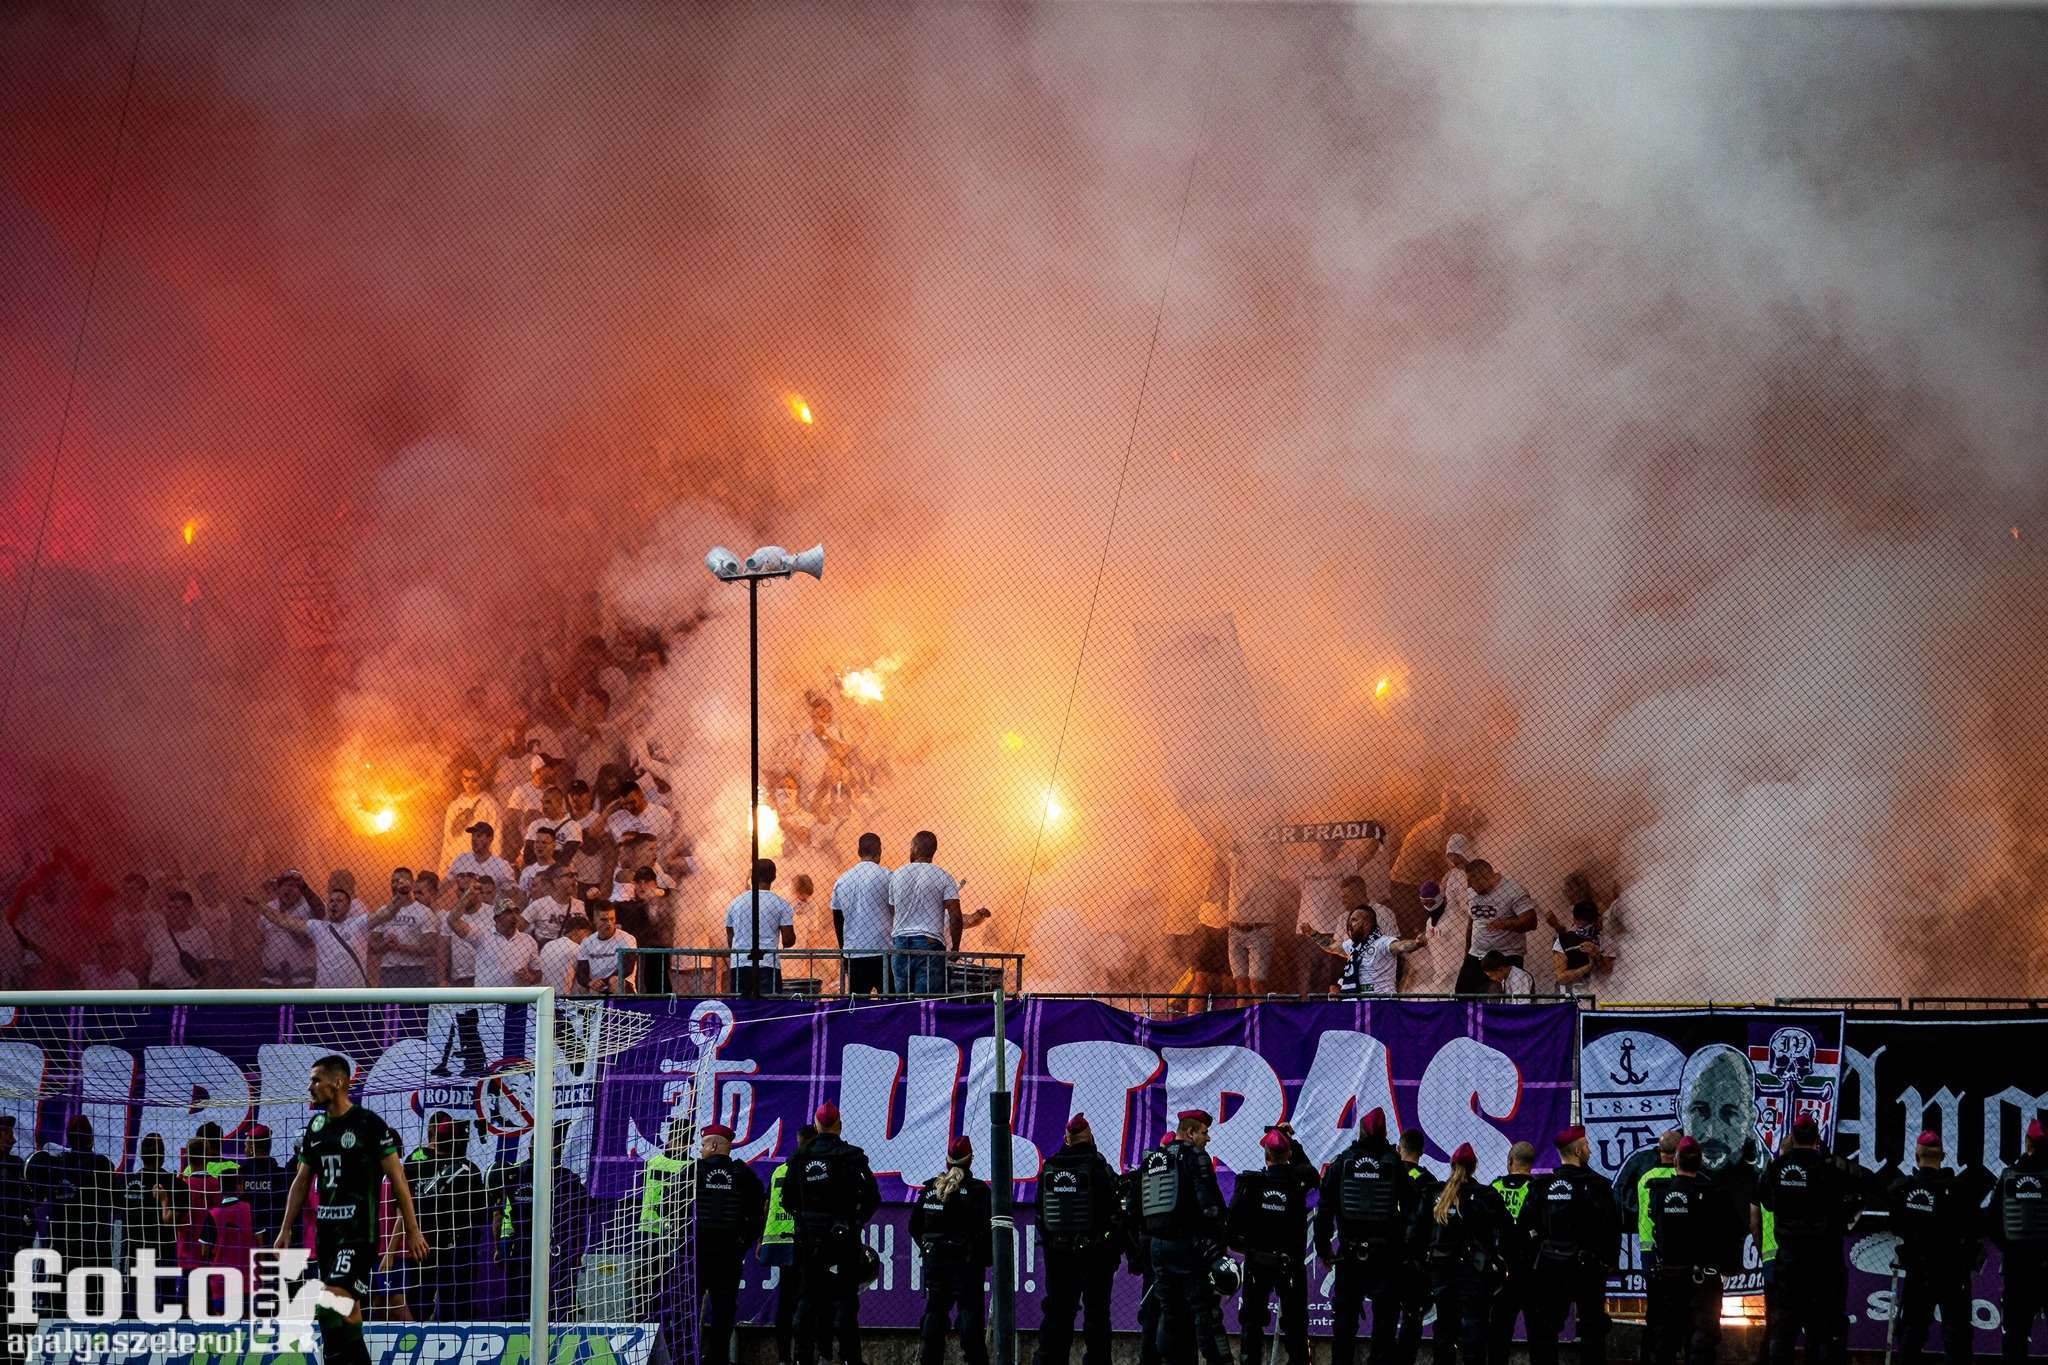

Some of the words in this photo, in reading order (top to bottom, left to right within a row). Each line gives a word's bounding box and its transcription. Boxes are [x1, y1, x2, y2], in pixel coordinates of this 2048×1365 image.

[838, 1029, 1523, 1188] ULTRAS
[244, 1179, 273, 1191] POLICE
[335, 1255, 351, 1274] 15
